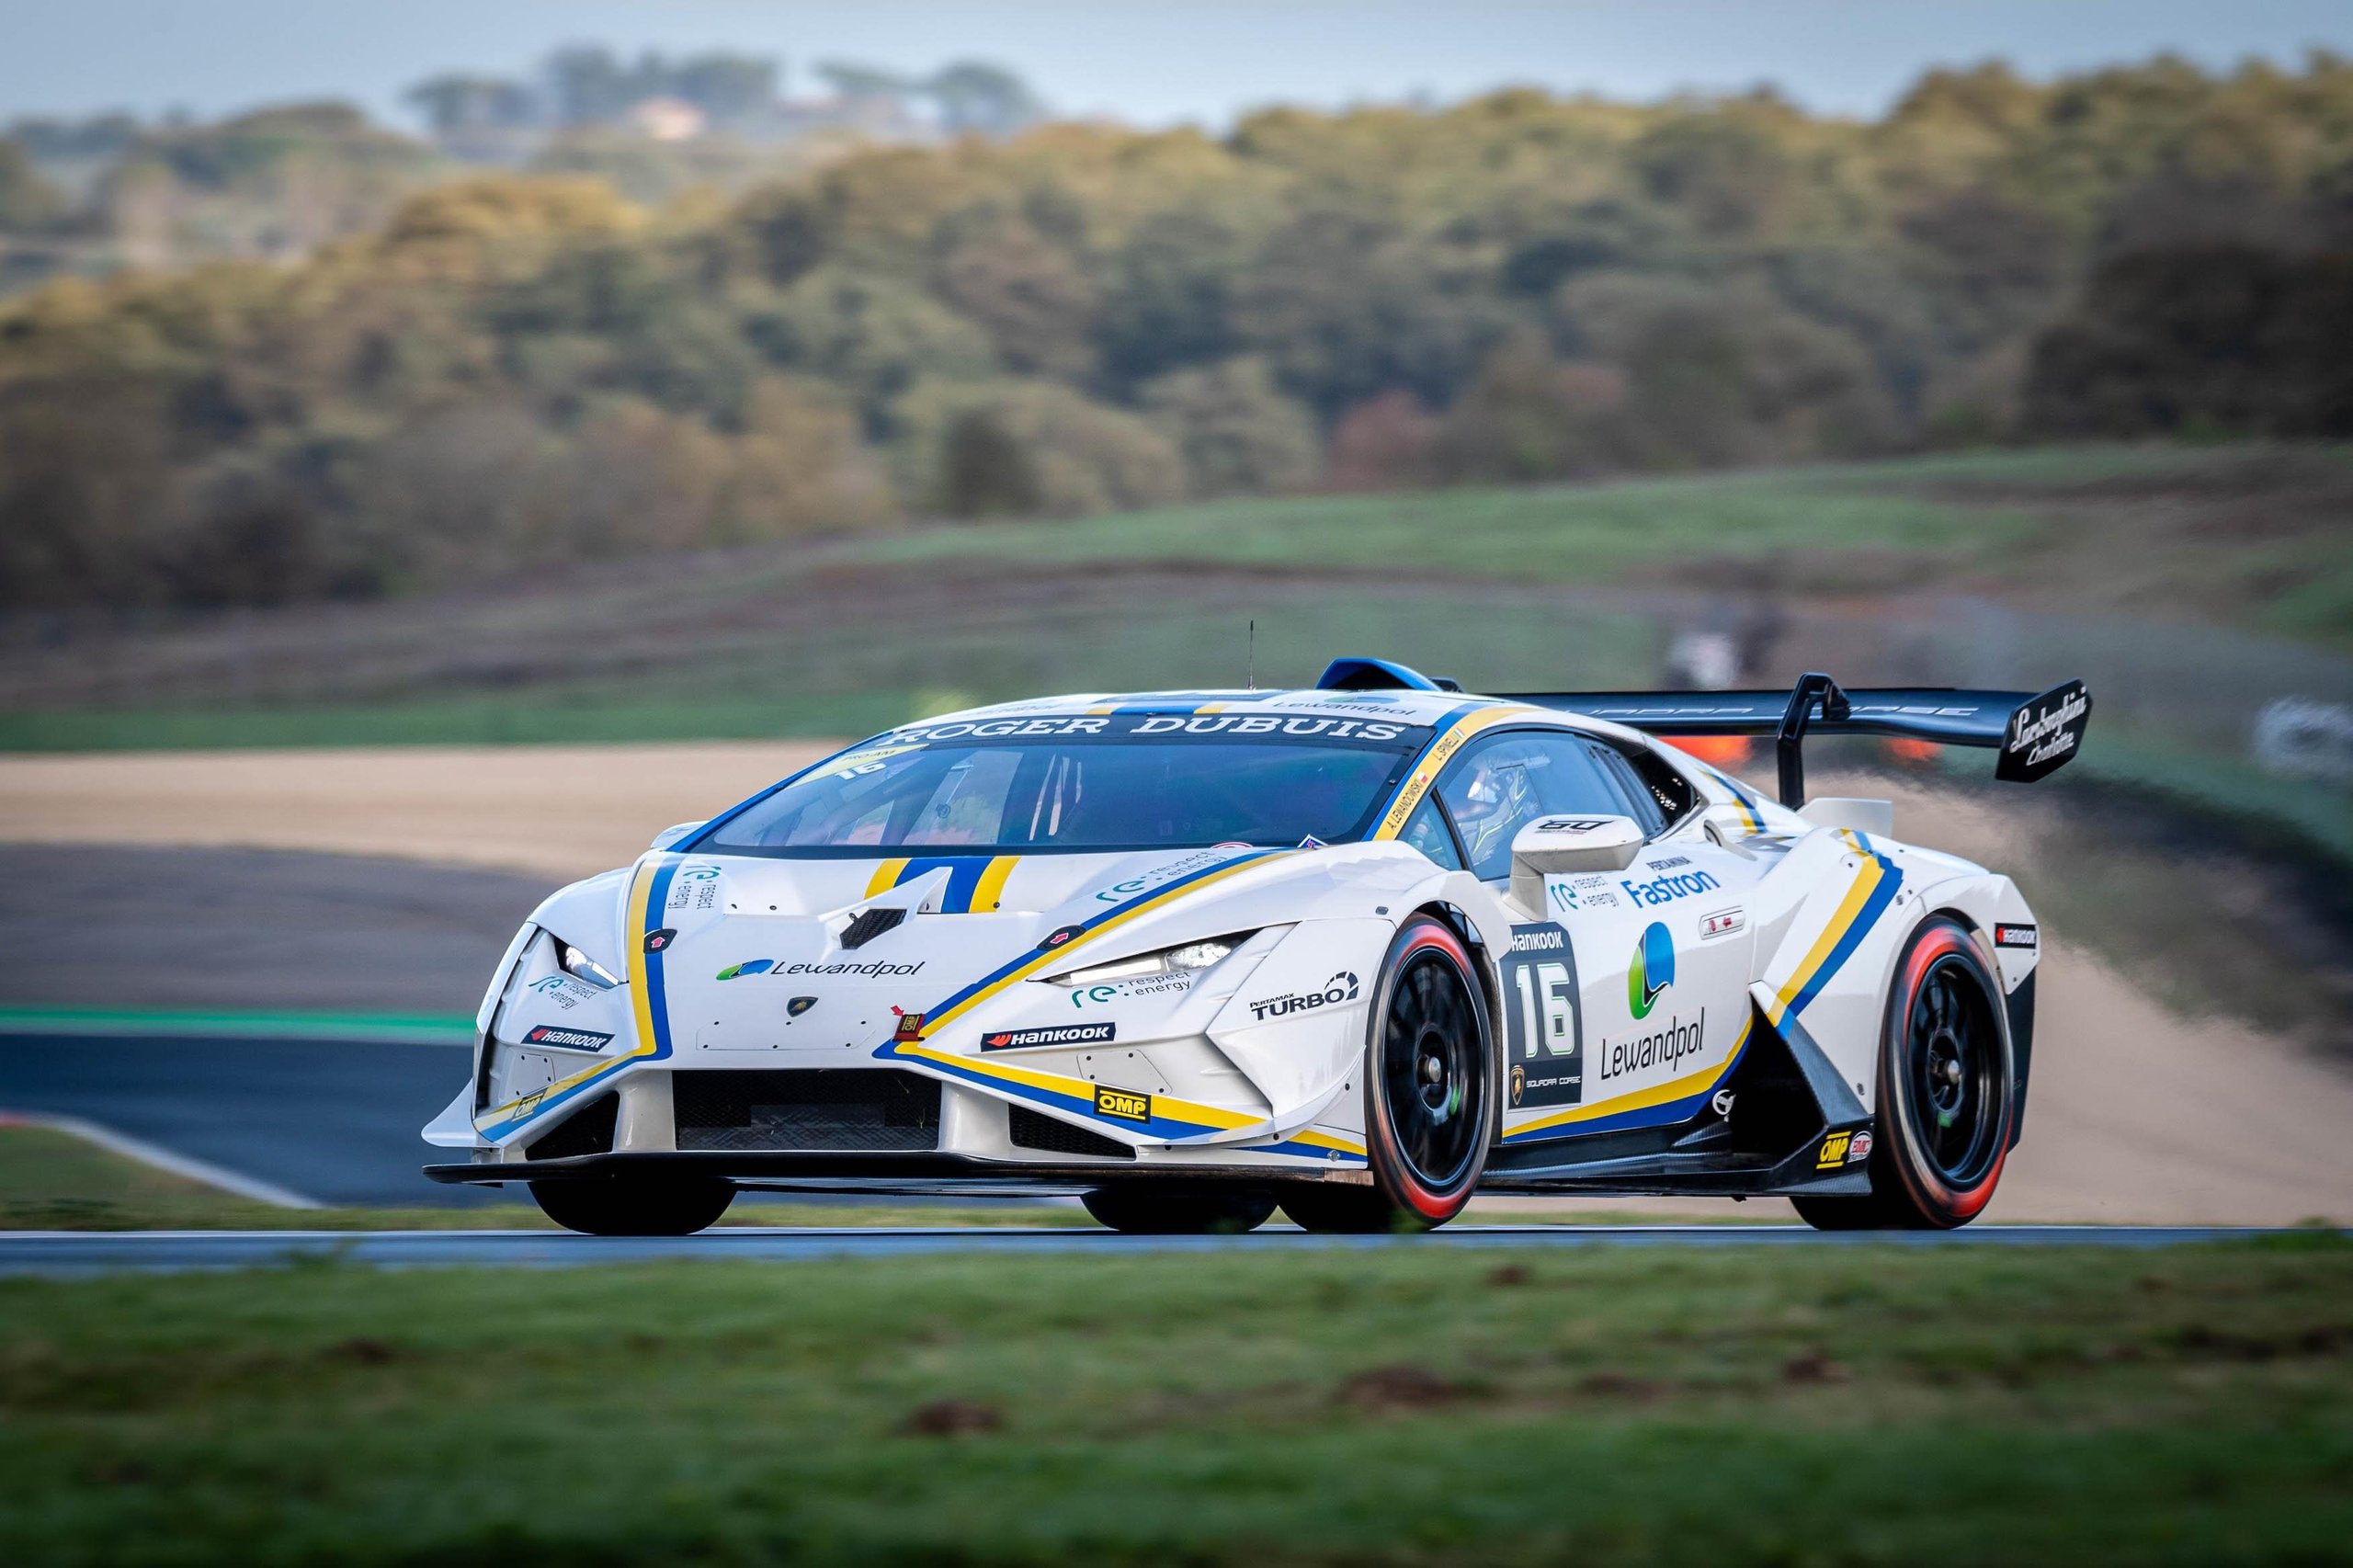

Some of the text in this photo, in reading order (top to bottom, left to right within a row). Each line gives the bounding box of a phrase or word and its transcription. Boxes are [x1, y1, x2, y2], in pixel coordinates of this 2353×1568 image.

[1272, 701, 1417, 717] Lewandpol
[875, 716, 1406, 747] ROGER DUBUIS
[835, 760, 887, 780] 16
[1167, 856, 1228, 876] energy
[1646, 856, 1694, 872] PERTAMINA
[667, 885, 691, 909] energy
[695, 884, 716, 909] respect
[1620, 870, 1722, 909] Fastron
[1587, 892, 1620, 908] energy
[770, 960, 926, 979] Lewandpol
[1128, 971, 1192, 986] respect
[565, 982, 597, 1000] respect
[1134, 981, 1191, 996] energy
[551, 992, 579, 1010] energy
[1250, 993, 1295, 1008] PERTAMAX
[1251, 988, 1346, 1021] TURBO
[1515, 962, 1575, 1059] 16
[1601, 1006, 1705, 1080] Lewandpol
[1526, 1075, 1582, 1088] SQUADRA CORSE
[515, 1096, 541, 1118] OMP
[1098, 1095, 1146, 1115] OMP
[1820, 1137, 1849, 1163] OMP
